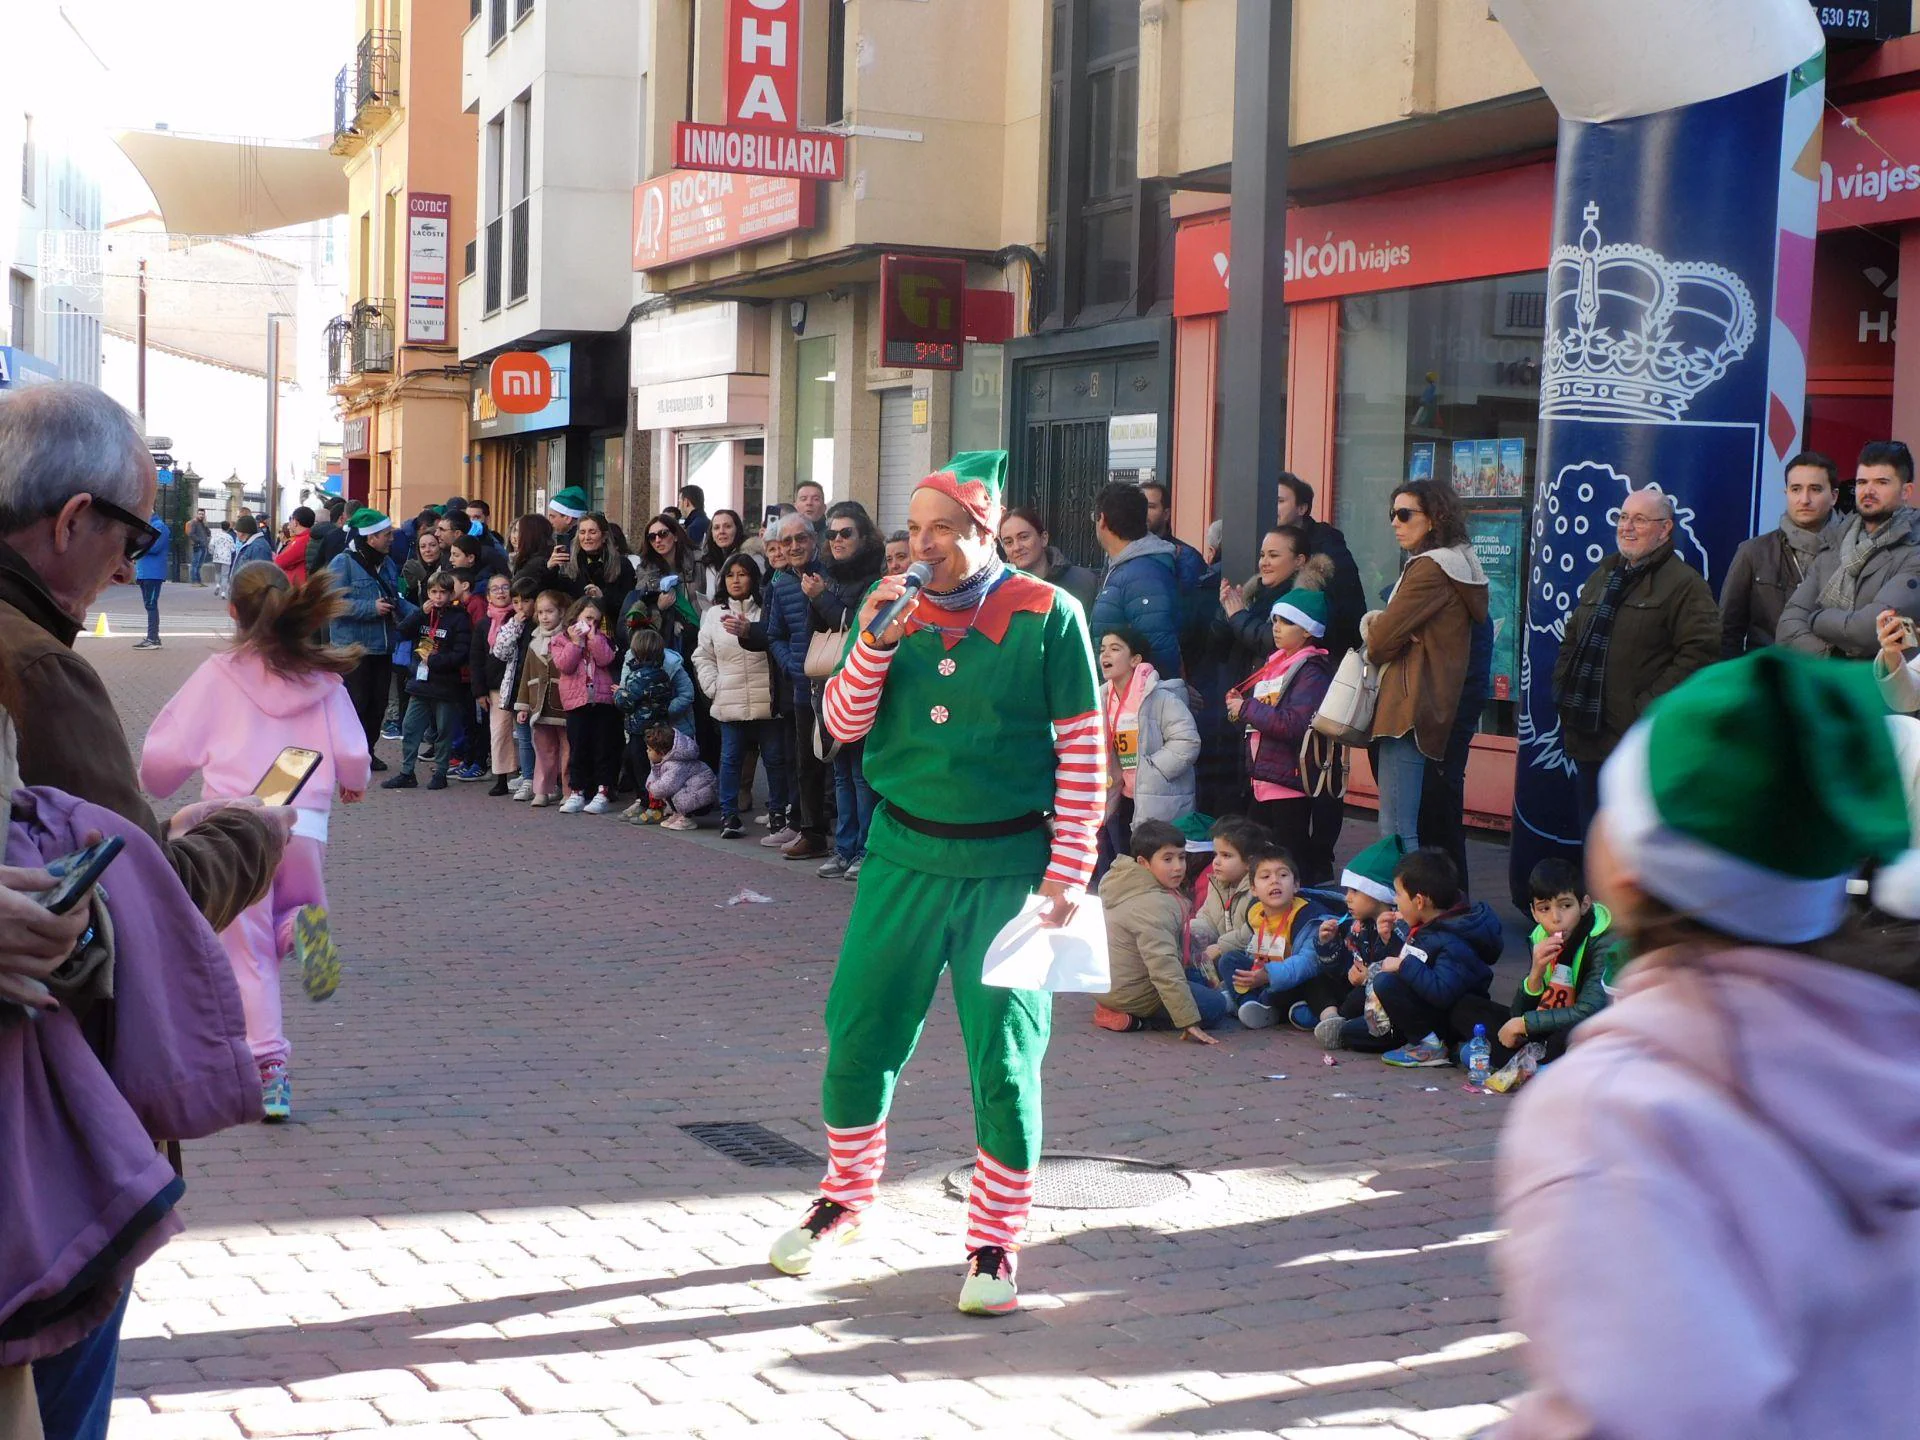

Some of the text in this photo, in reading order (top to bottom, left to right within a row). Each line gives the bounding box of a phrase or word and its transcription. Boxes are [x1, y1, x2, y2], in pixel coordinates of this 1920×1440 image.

[1821, 7, 1844, 26] 530
[1847, 9, 1870, 28] 573
[684, 128, 836, 176] INMOBILIARIA
[670, 171, 734, 213] ROCHA
[1837, 159, 1920, 202] viajes
[1359, 240, 1410, 273] viajes
[409, 319, 445, 327] CARAMELO
[1474, 535, 1500, 544] SEGUNDA
[1541, 986, 1568, 1009] 28
